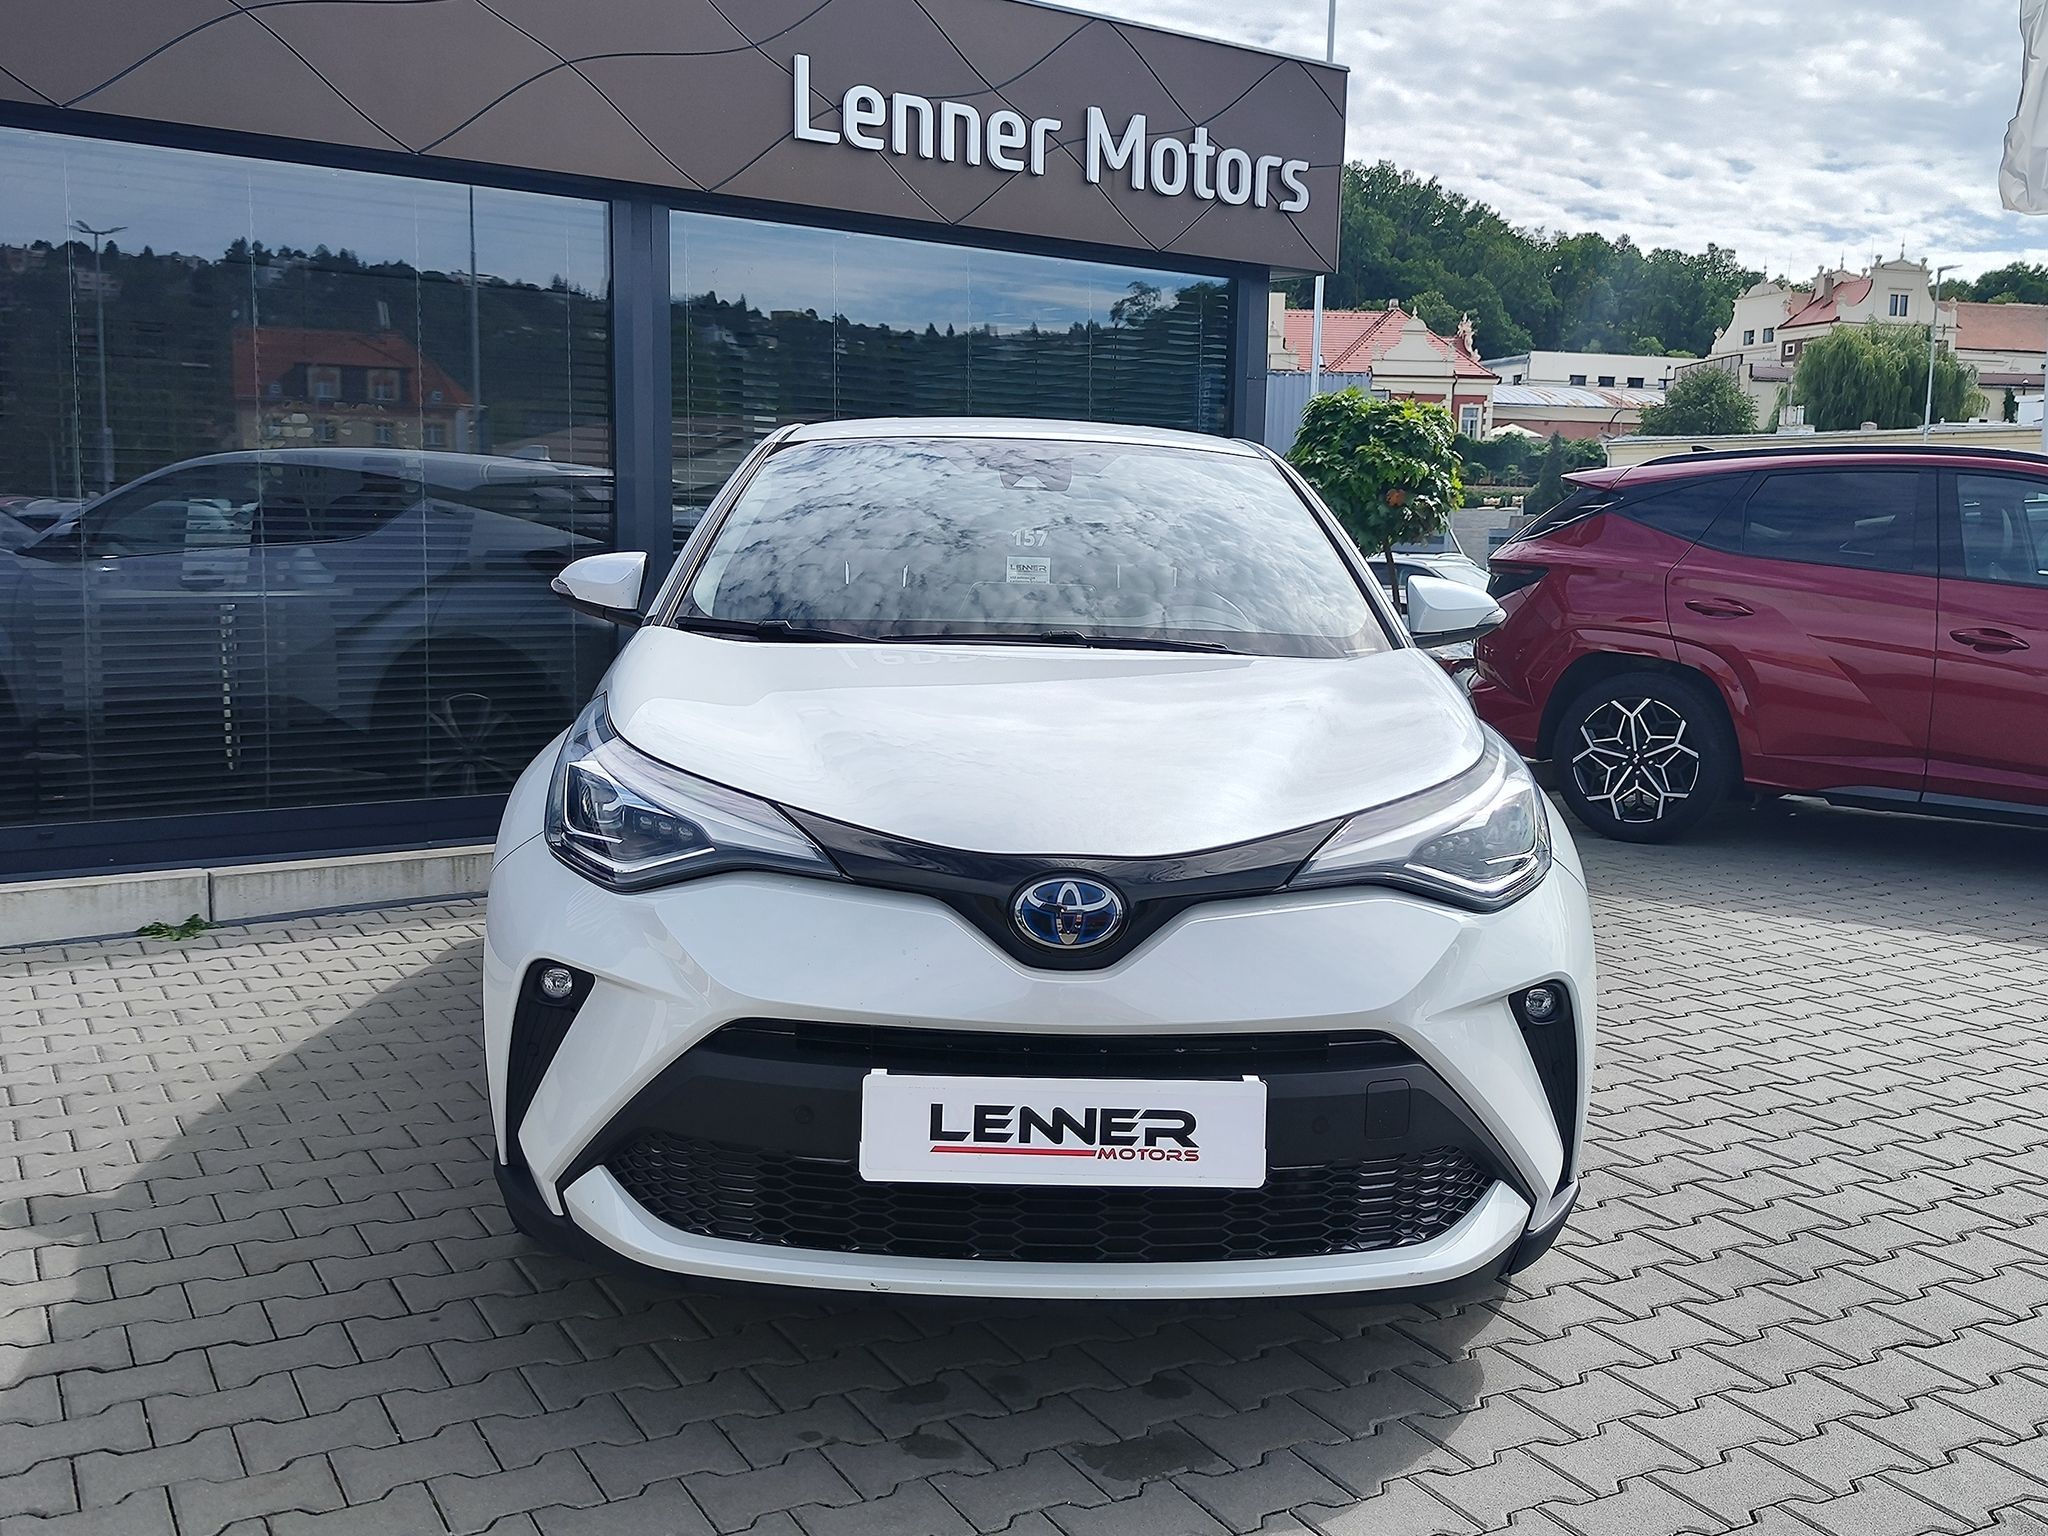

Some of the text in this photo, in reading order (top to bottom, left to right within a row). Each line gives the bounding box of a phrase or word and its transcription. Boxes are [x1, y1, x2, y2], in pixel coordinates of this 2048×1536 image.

[791, 53, 1311, 213] Lenner Motors
[1012, 530, 1049, 547] 157
[929, 1103, 1199, 1147] LENNER
[1097, 1148, 1200, 1162] MOTORS
